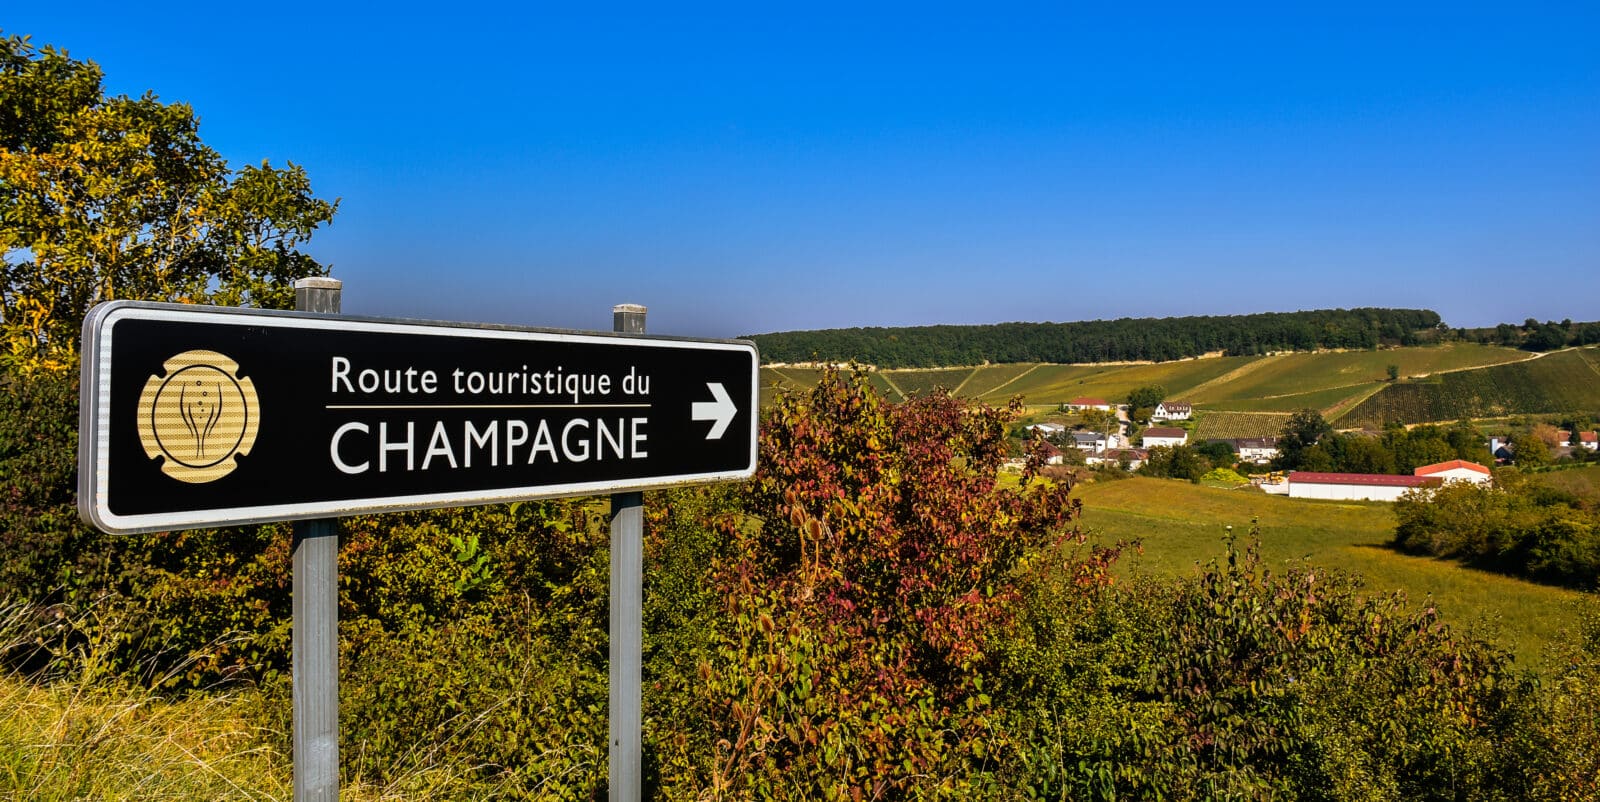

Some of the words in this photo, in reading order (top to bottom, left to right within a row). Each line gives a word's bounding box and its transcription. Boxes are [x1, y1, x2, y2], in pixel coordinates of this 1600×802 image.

[331, 356, 438, 394] Route
[452, 364, 611, 404] touristique
[622, 365, 650, 395] du
[330, 417, 648, 475] CHAMPAGNE
